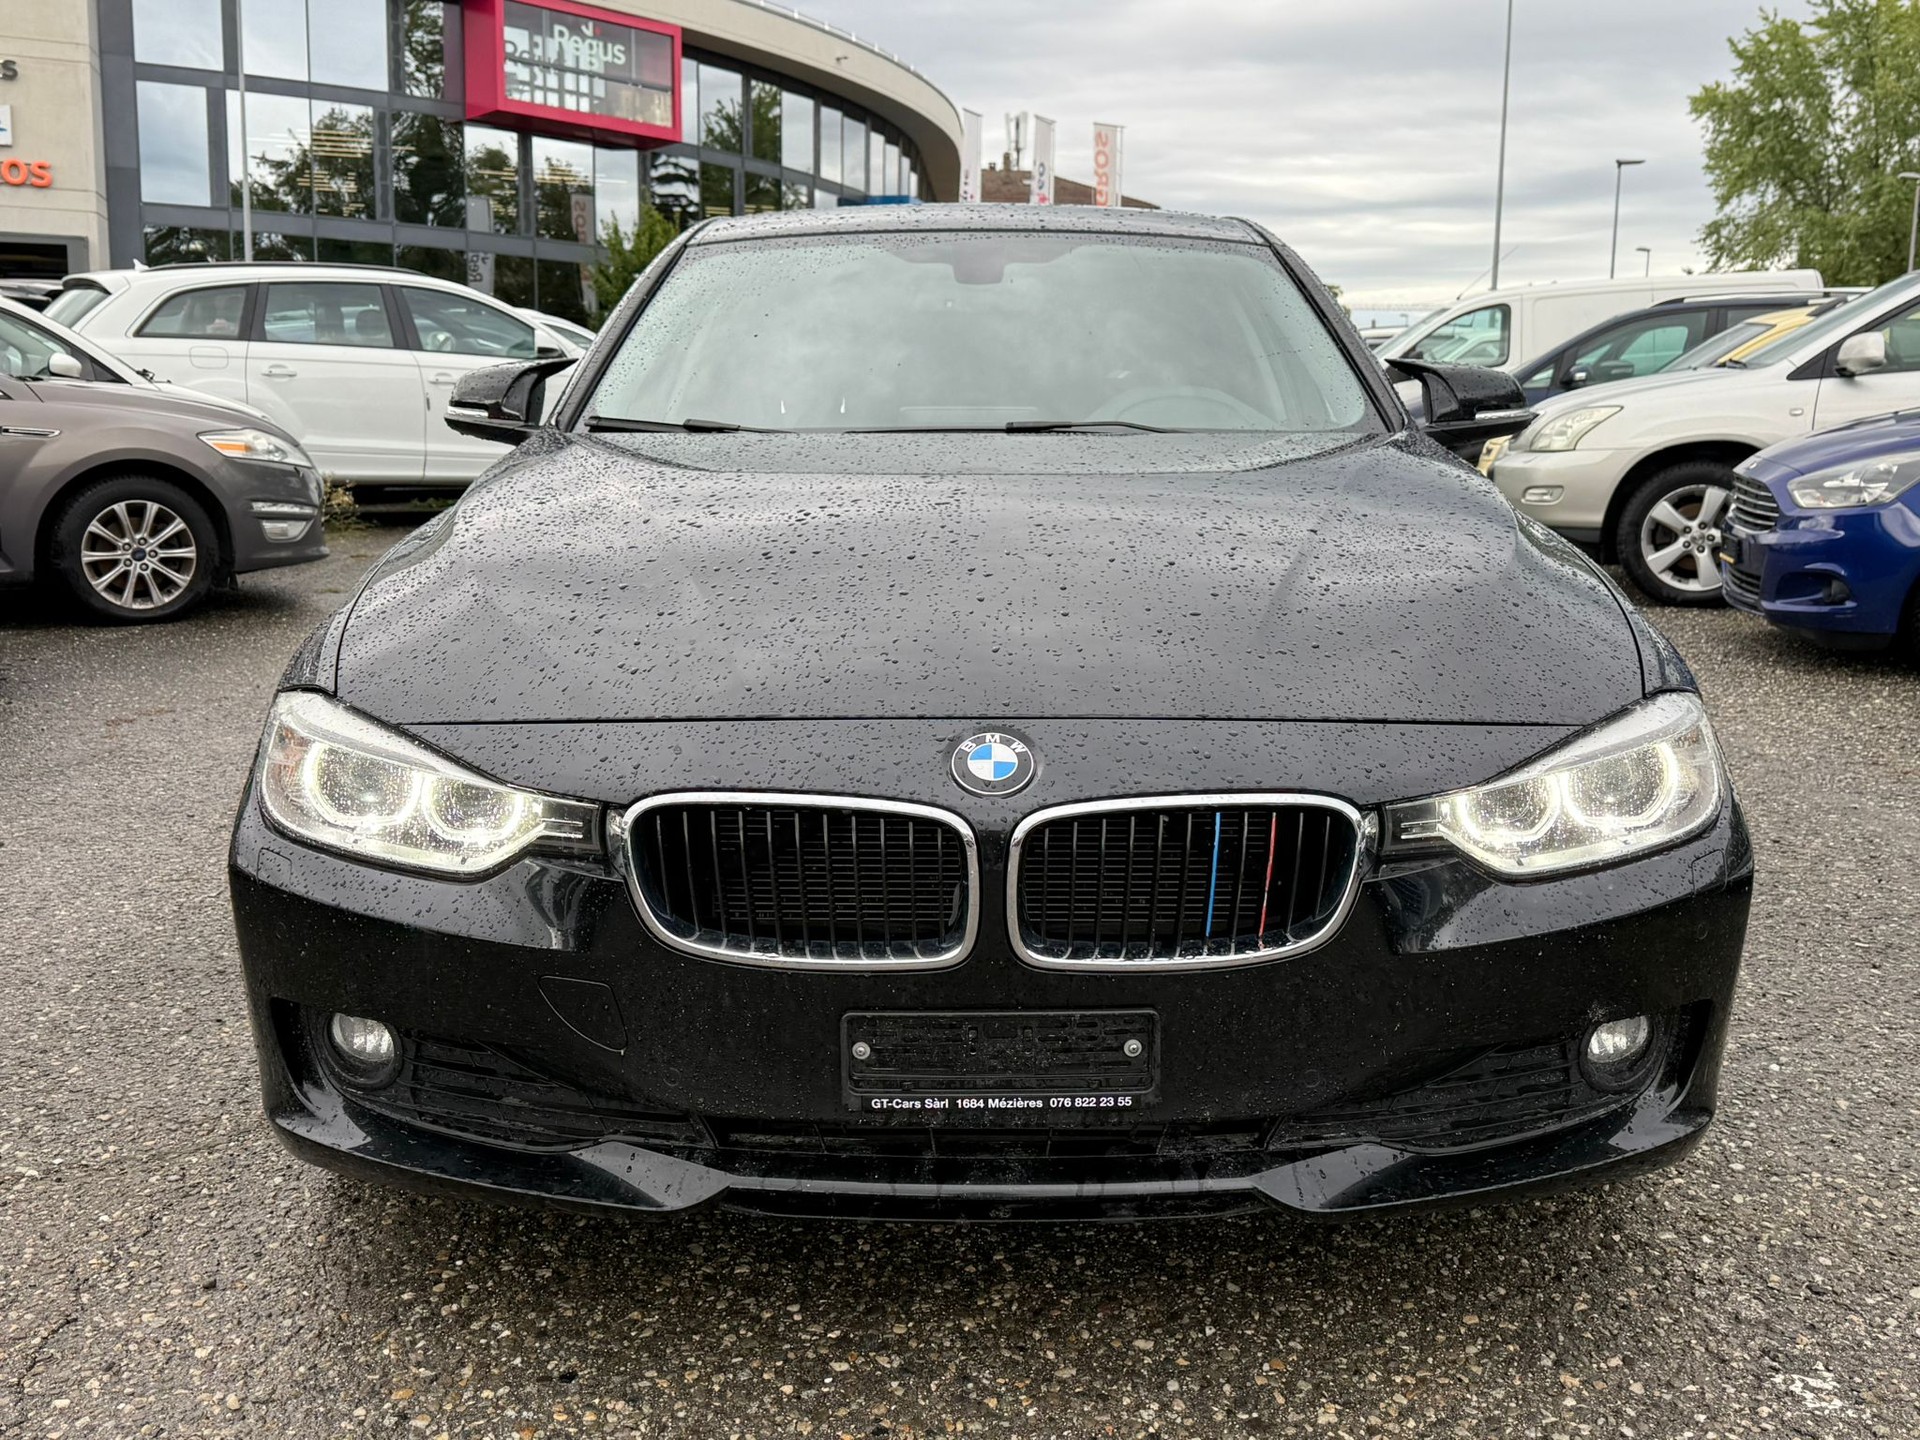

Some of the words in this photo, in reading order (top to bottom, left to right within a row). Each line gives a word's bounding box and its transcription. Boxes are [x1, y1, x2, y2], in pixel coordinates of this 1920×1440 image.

[553, 24, 626, 67] Regus
[960, 734, 1027, 753] BMW
[871, 1098, 921, 1109] GT-Cars
[924, 1098, 949, 1109] Sàrl
[956, 1098, 985, 1109] 1684
[988, 1097, 1043, 1109] Mézières
[1049, 1097, 1072, 1108] 076
[1074, 1097, 1097, 1107] 822
[1099, 1096, 1115, 1107] 23
[1117, 1096, 1132, 1107] 55
